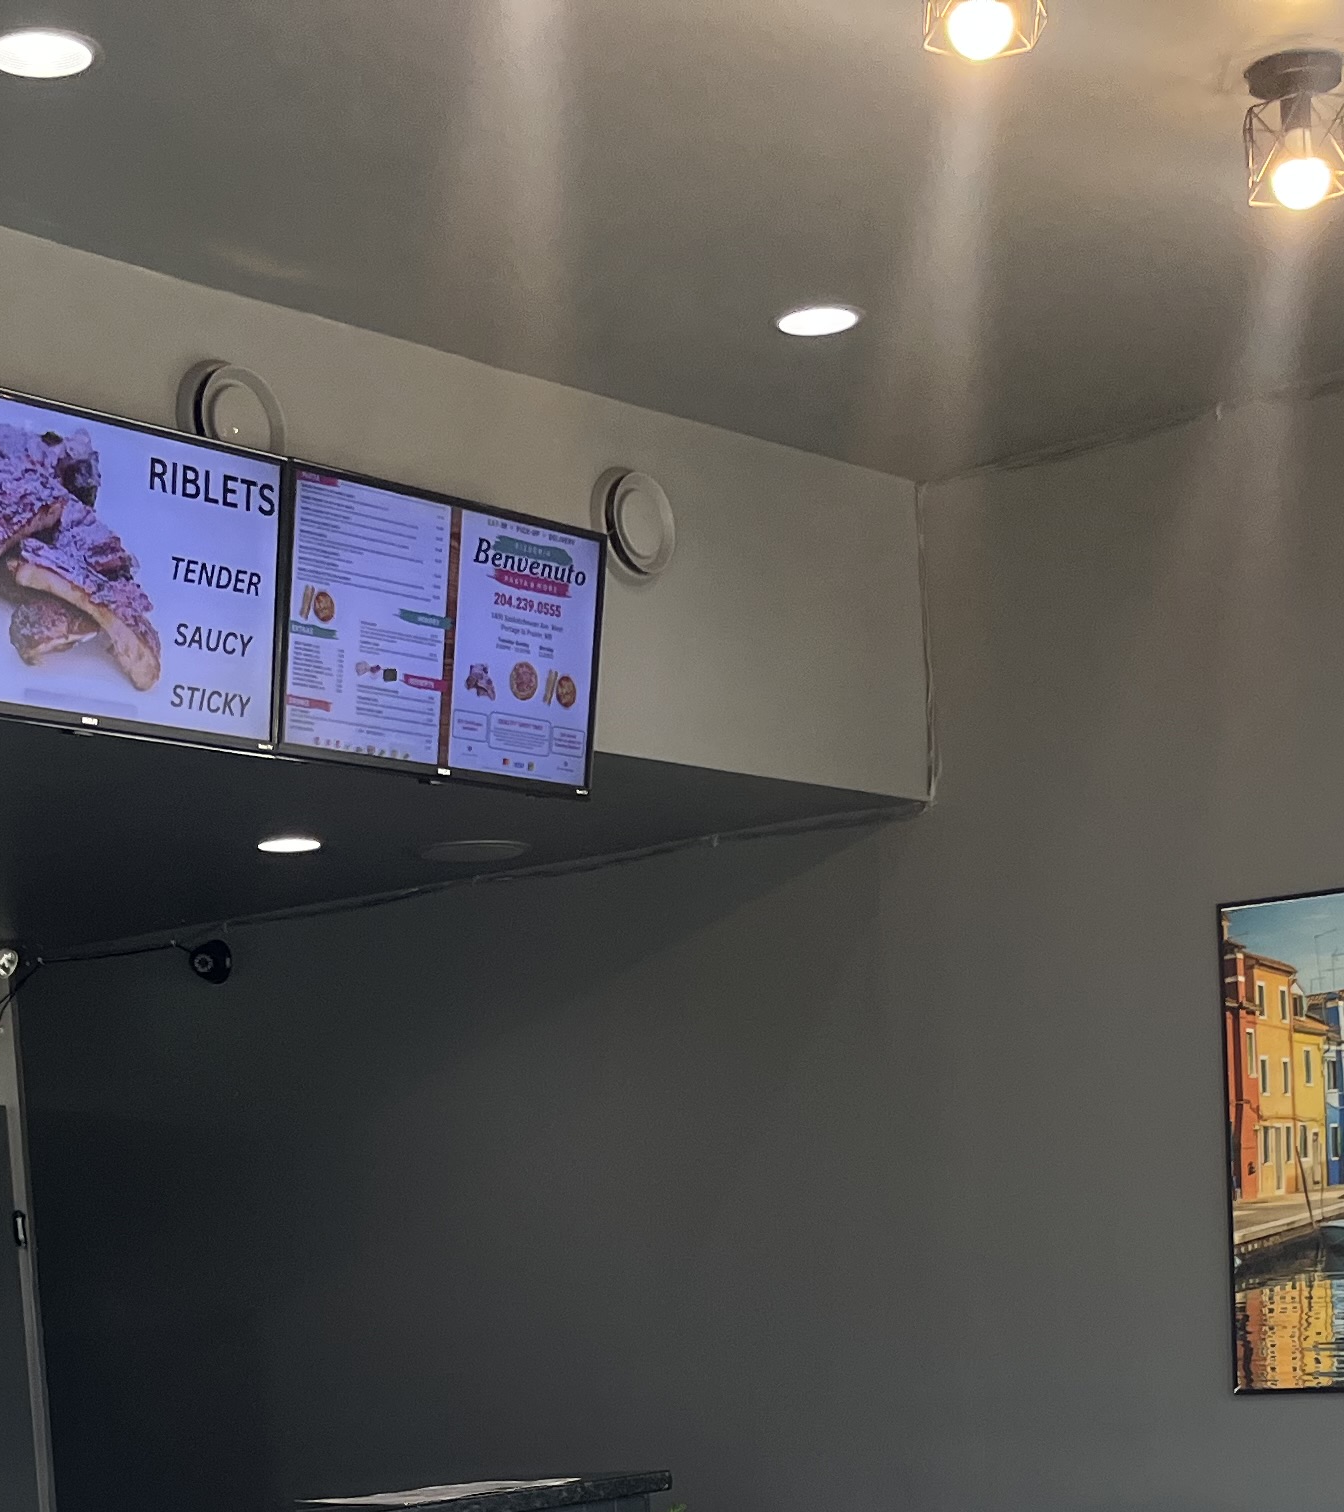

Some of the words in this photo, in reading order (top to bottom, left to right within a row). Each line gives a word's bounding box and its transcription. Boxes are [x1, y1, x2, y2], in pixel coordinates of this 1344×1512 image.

[149, 456, 277, 517] RIBLETS
[171, 556, 262, 597] TENDER
[473, 537, 587, 586] Benvenuto
[493, 592, 562, 618] 204.239.0555
[174, 623, 254, 657] SAUCY
[170, 684, 252, 718] STICKY
